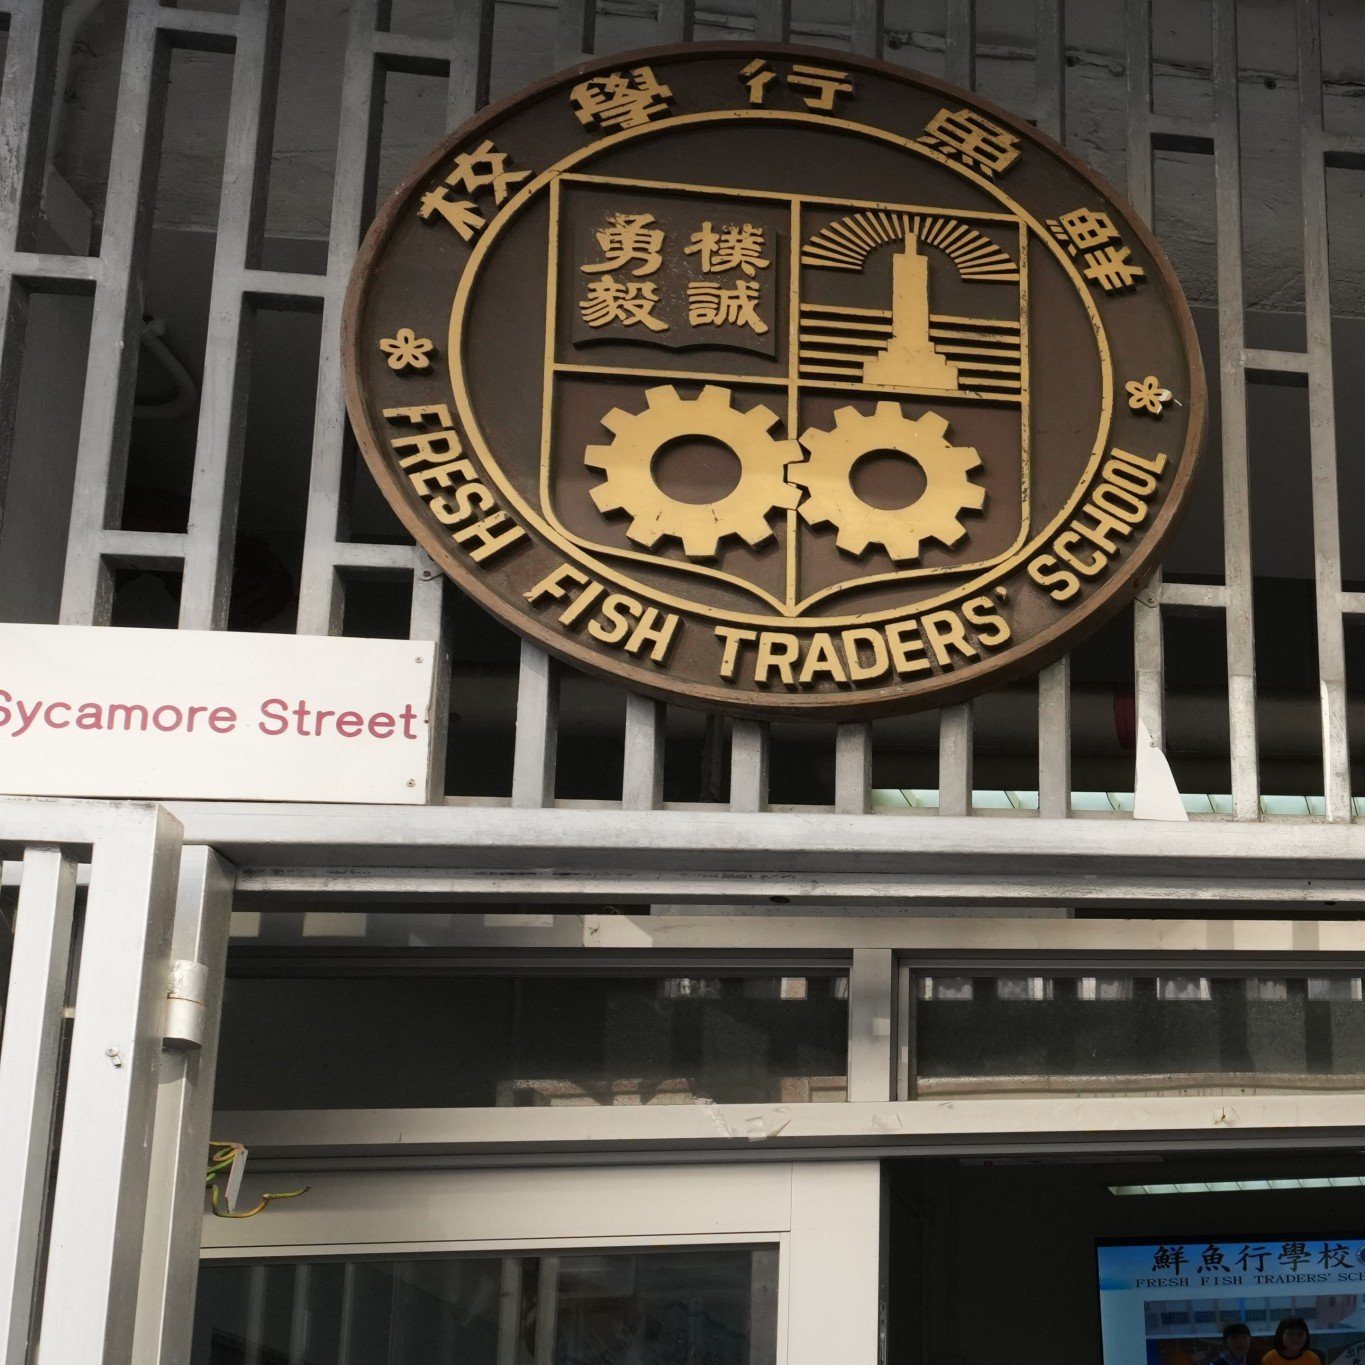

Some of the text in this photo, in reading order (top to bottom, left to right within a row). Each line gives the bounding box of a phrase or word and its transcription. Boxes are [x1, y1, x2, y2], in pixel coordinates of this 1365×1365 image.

[382, 402, 527, 565] FRESH
[525, 564, 684, 665] FISH
[1030, 447, 1168, 602] SCHOOL
[258, 698, 418, 740] Street
[1151, 1241, 1356, 1275] 鮮魚行學校
[1135, 1276, 1189, 1288] FRESH
[1201, 1274, 1243, 1286] FISH
